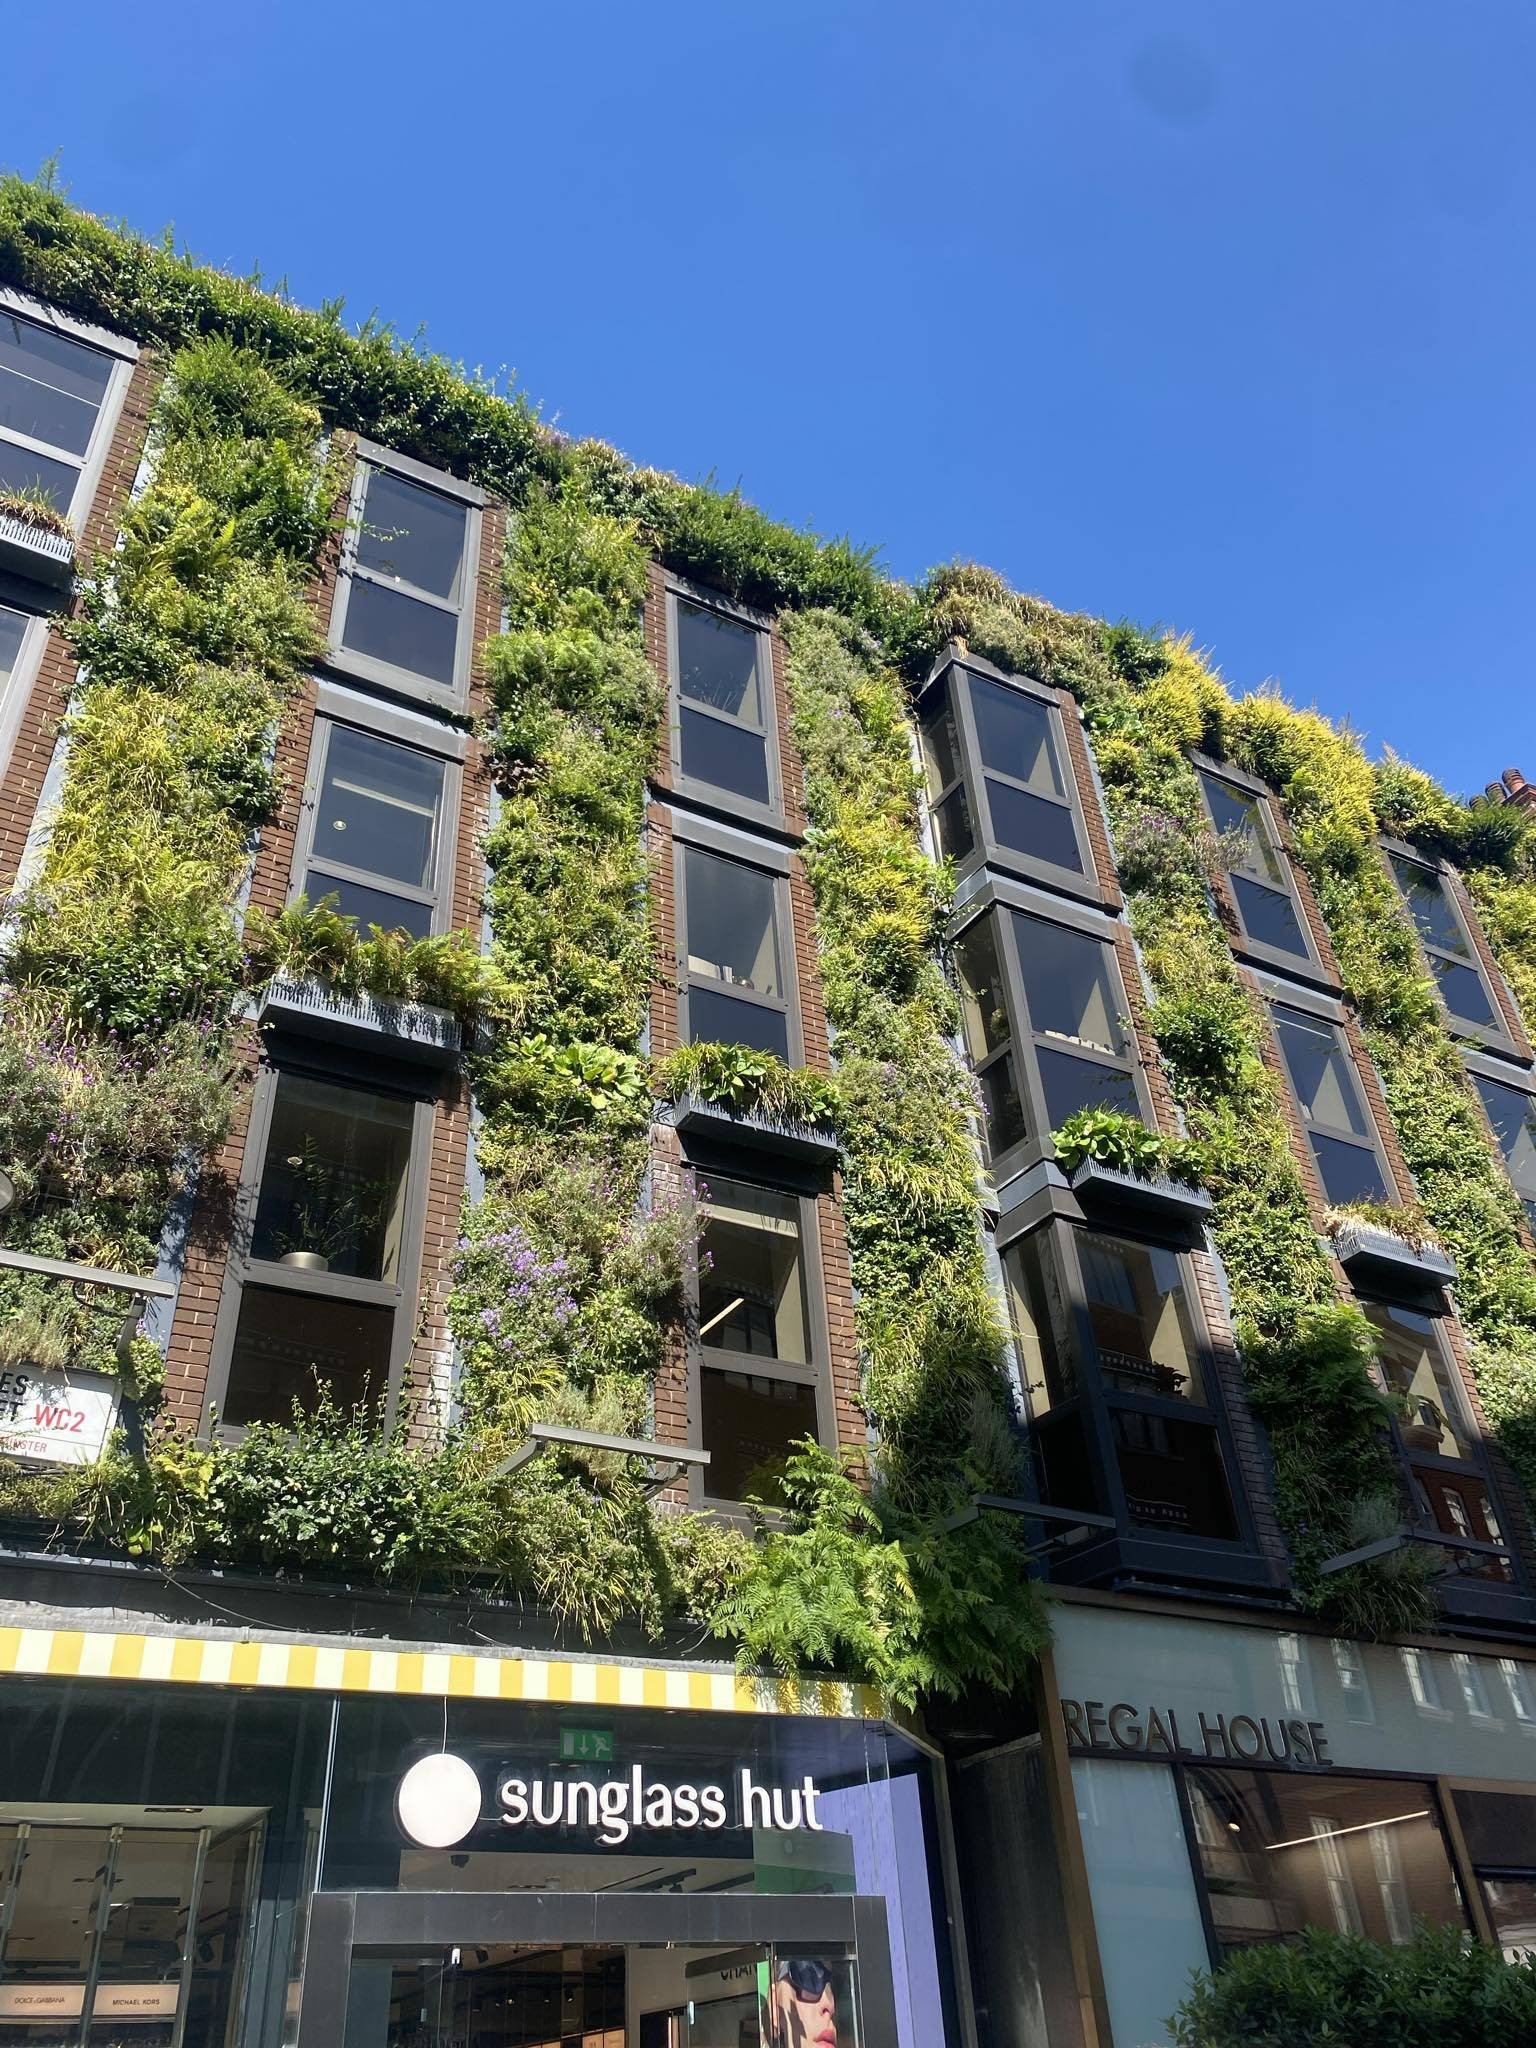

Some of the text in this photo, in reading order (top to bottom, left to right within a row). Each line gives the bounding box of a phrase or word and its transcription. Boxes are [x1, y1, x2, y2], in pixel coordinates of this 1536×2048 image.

[35, 1403, 86, 1433] WC2
[1060, 1699, 1334, 1766] REGAL HOUSE
[500, 1764, 823, 1845] sunglass hut
